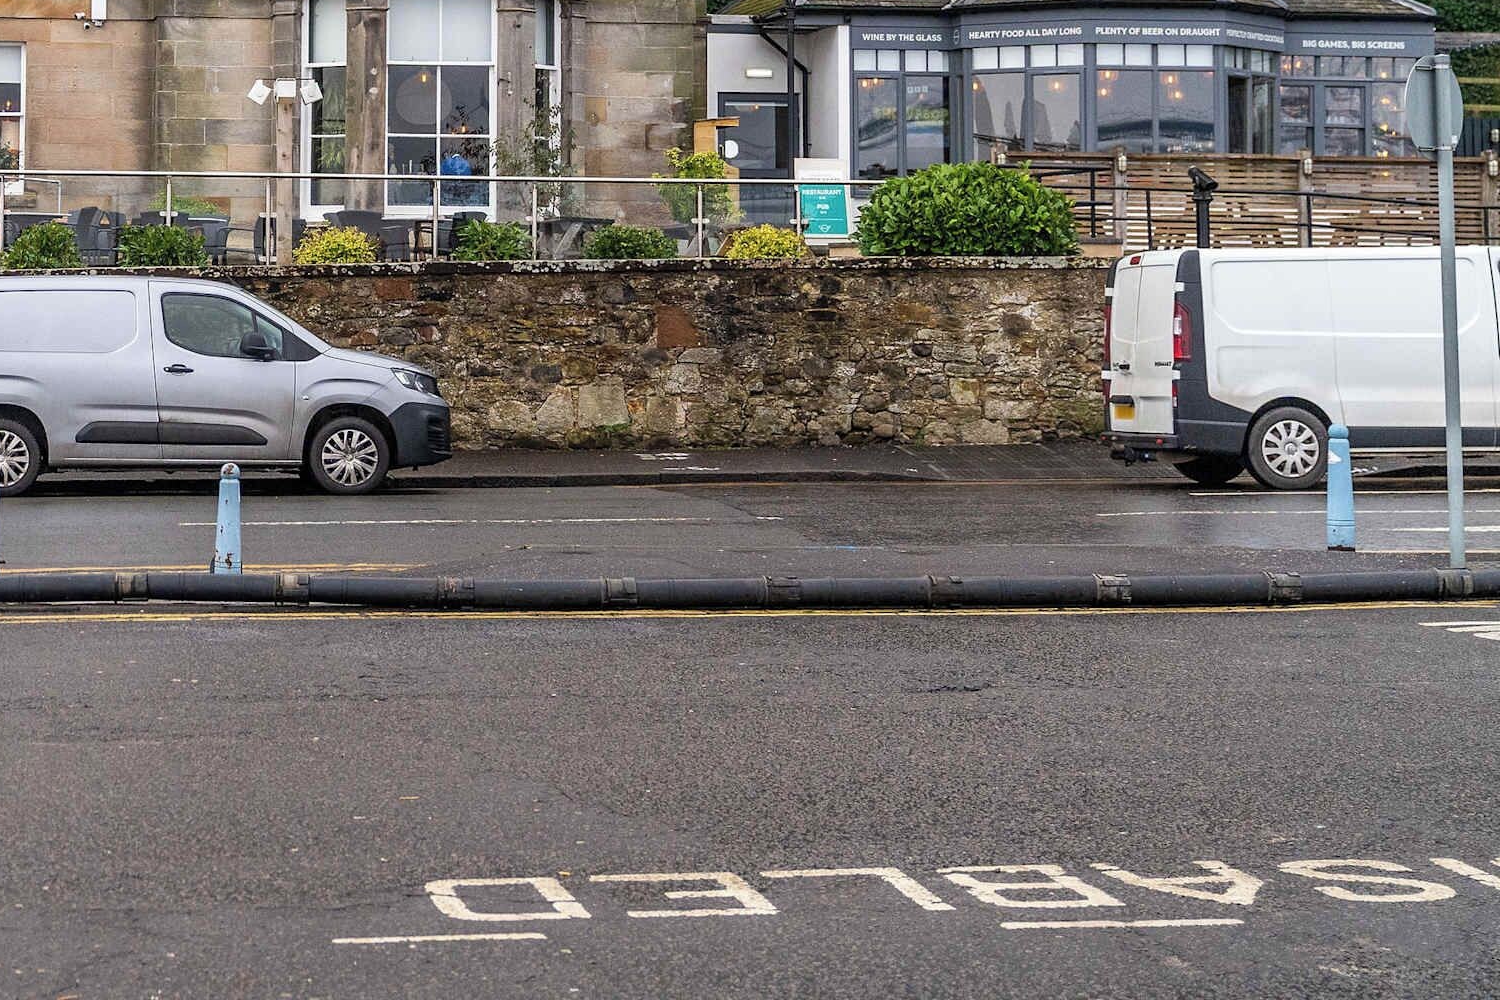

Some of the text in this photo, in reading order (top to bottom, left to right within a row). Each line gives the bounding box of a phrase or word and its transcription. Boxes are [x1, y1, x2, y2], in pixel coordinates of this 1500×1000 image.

[969, 27, 1082, 40] HEARTY FOOD ALL DAY LONG
[1095, 27, 1221, 36] PLENTY OF BEER ON DRAUGHT
[862, 33, 885, 41] WINE
[886, 33, 897, 41] BY
[915, 34, 942, 42] GLASS
[1302, 40, 1405, 49] BIG GAMES, BIG SCREENS
